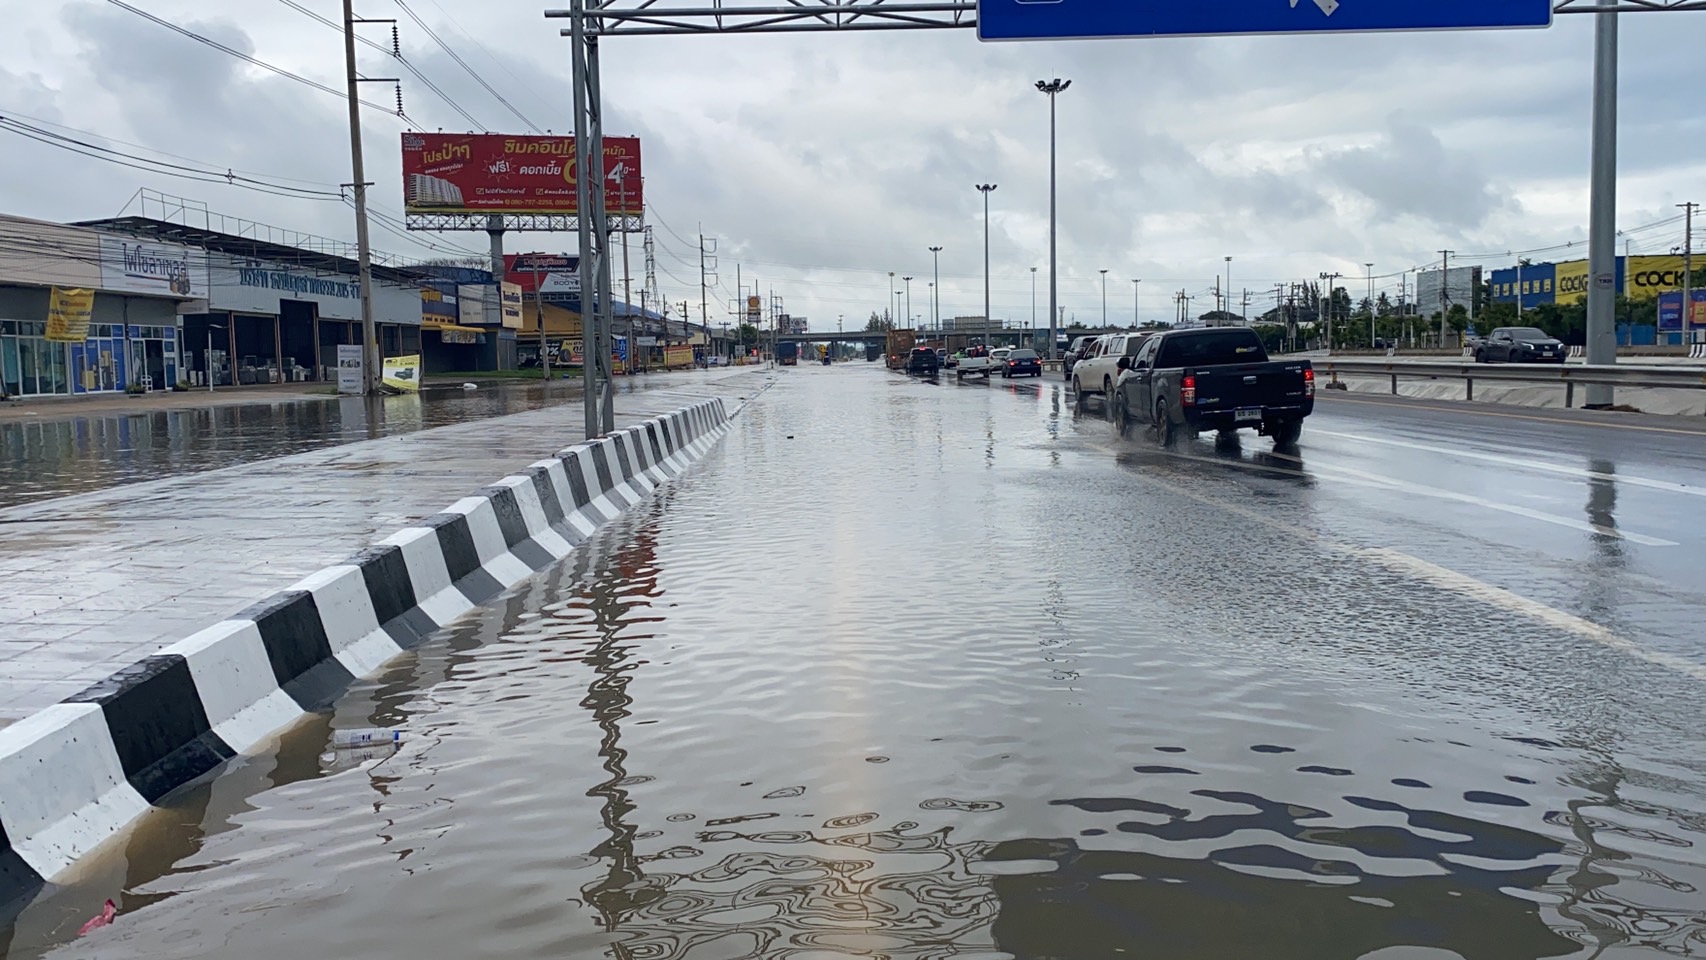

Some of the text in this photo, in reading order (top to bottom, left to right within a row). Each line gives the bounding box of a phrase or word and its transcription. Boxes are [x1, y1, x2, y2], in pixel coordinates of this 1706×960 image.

[488, 160, 510, 174] ฟรี!
[519, 160, 561, 175] ดอกเบี้ย
[1634, 270, 1685, 287] COCK
